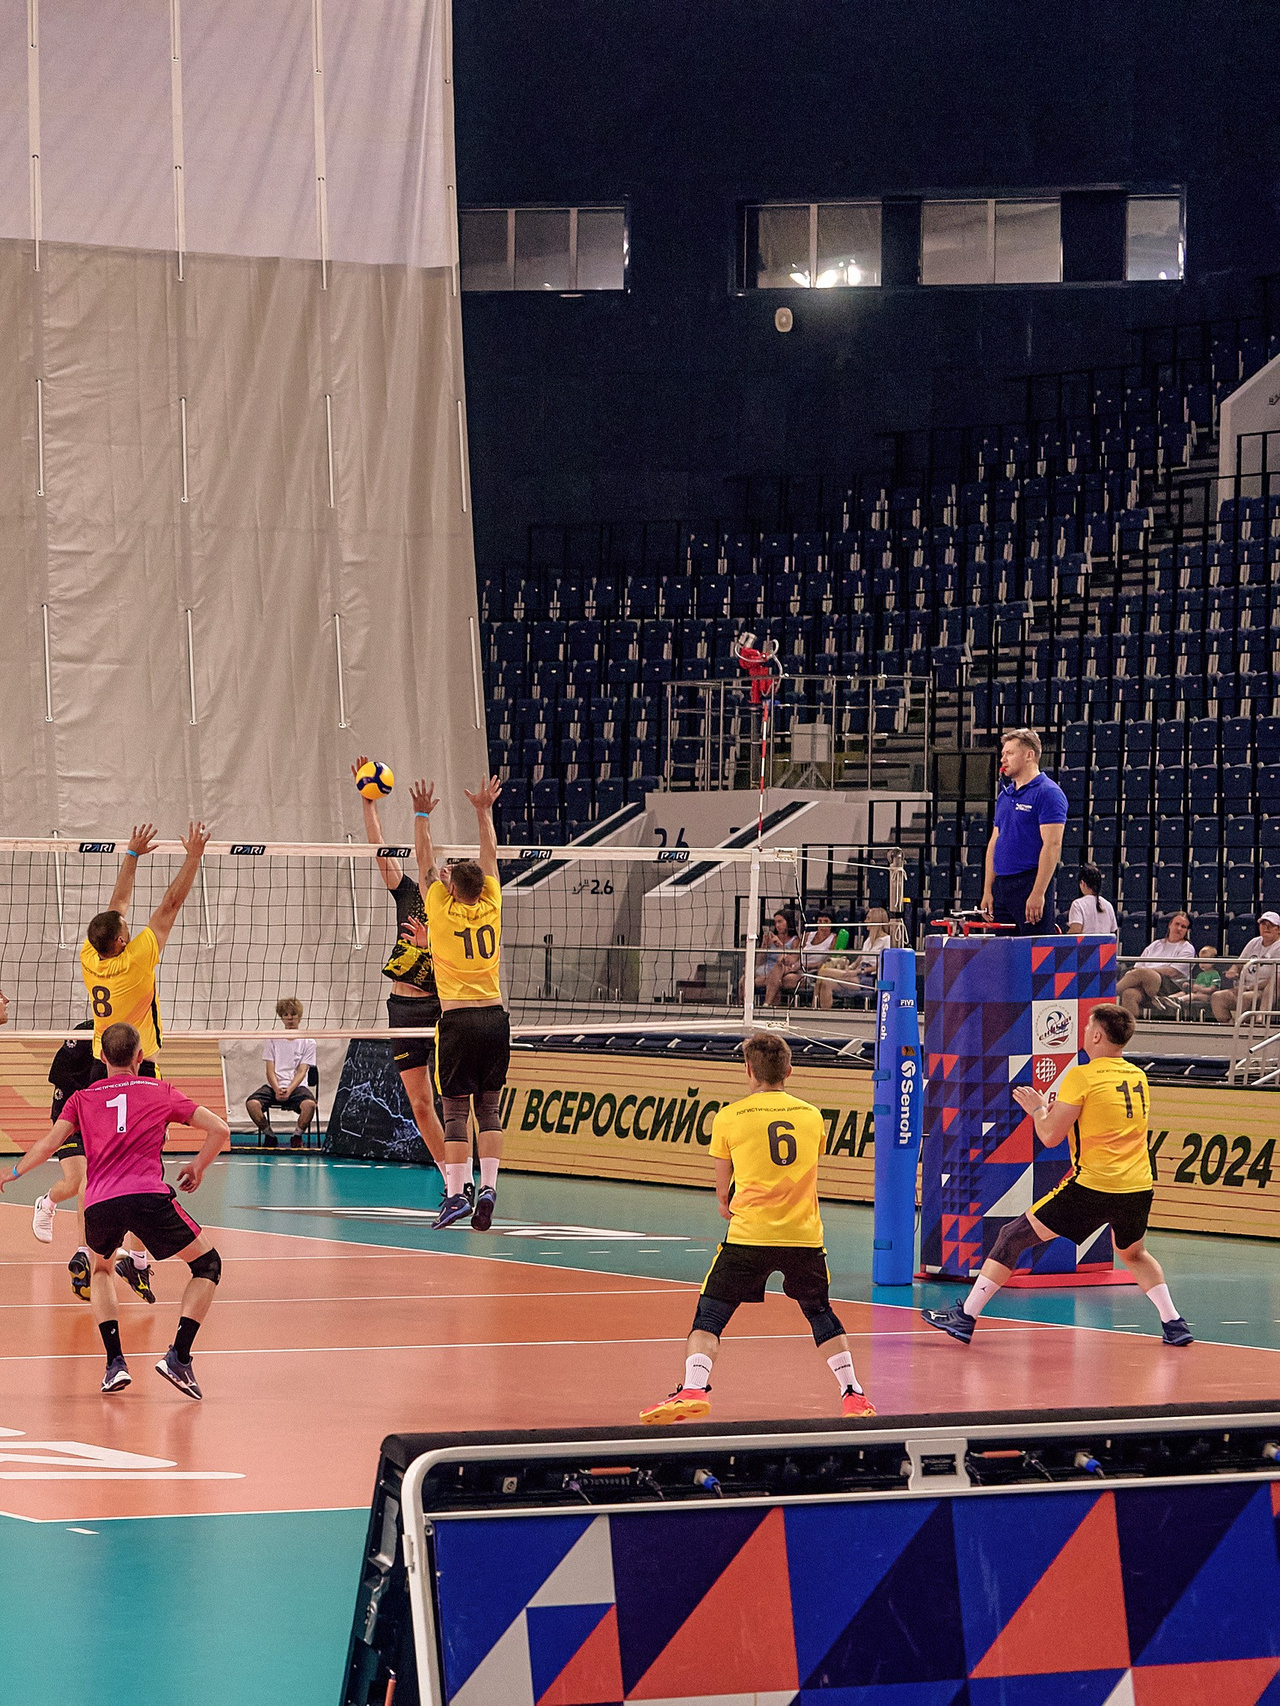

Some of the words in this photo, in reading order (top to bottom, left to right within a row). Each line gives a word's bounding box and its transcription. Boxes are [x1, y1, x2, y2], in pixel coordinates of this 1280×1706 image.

[81, 843, 114, 853] PARI
[233, 845, 265, 856] PARI
[380, 848, 411, 858] PARI
[522, 849, 551, 859] PARI
[660, 851, 688, 860] PARI
[590, 879, 615, 896] 2.6
[453, 924, 496, 960] 10
[91, 985, 113, 1018] 8
[105, 1093, 128, 1134] 1
[899, 1079, 914, 1145] Senoh
[1116, 1080, 1147, 1119] 11
[767, 1120, 797, 1167] 6
[1174, 1132, 1277, 1189] 2024
